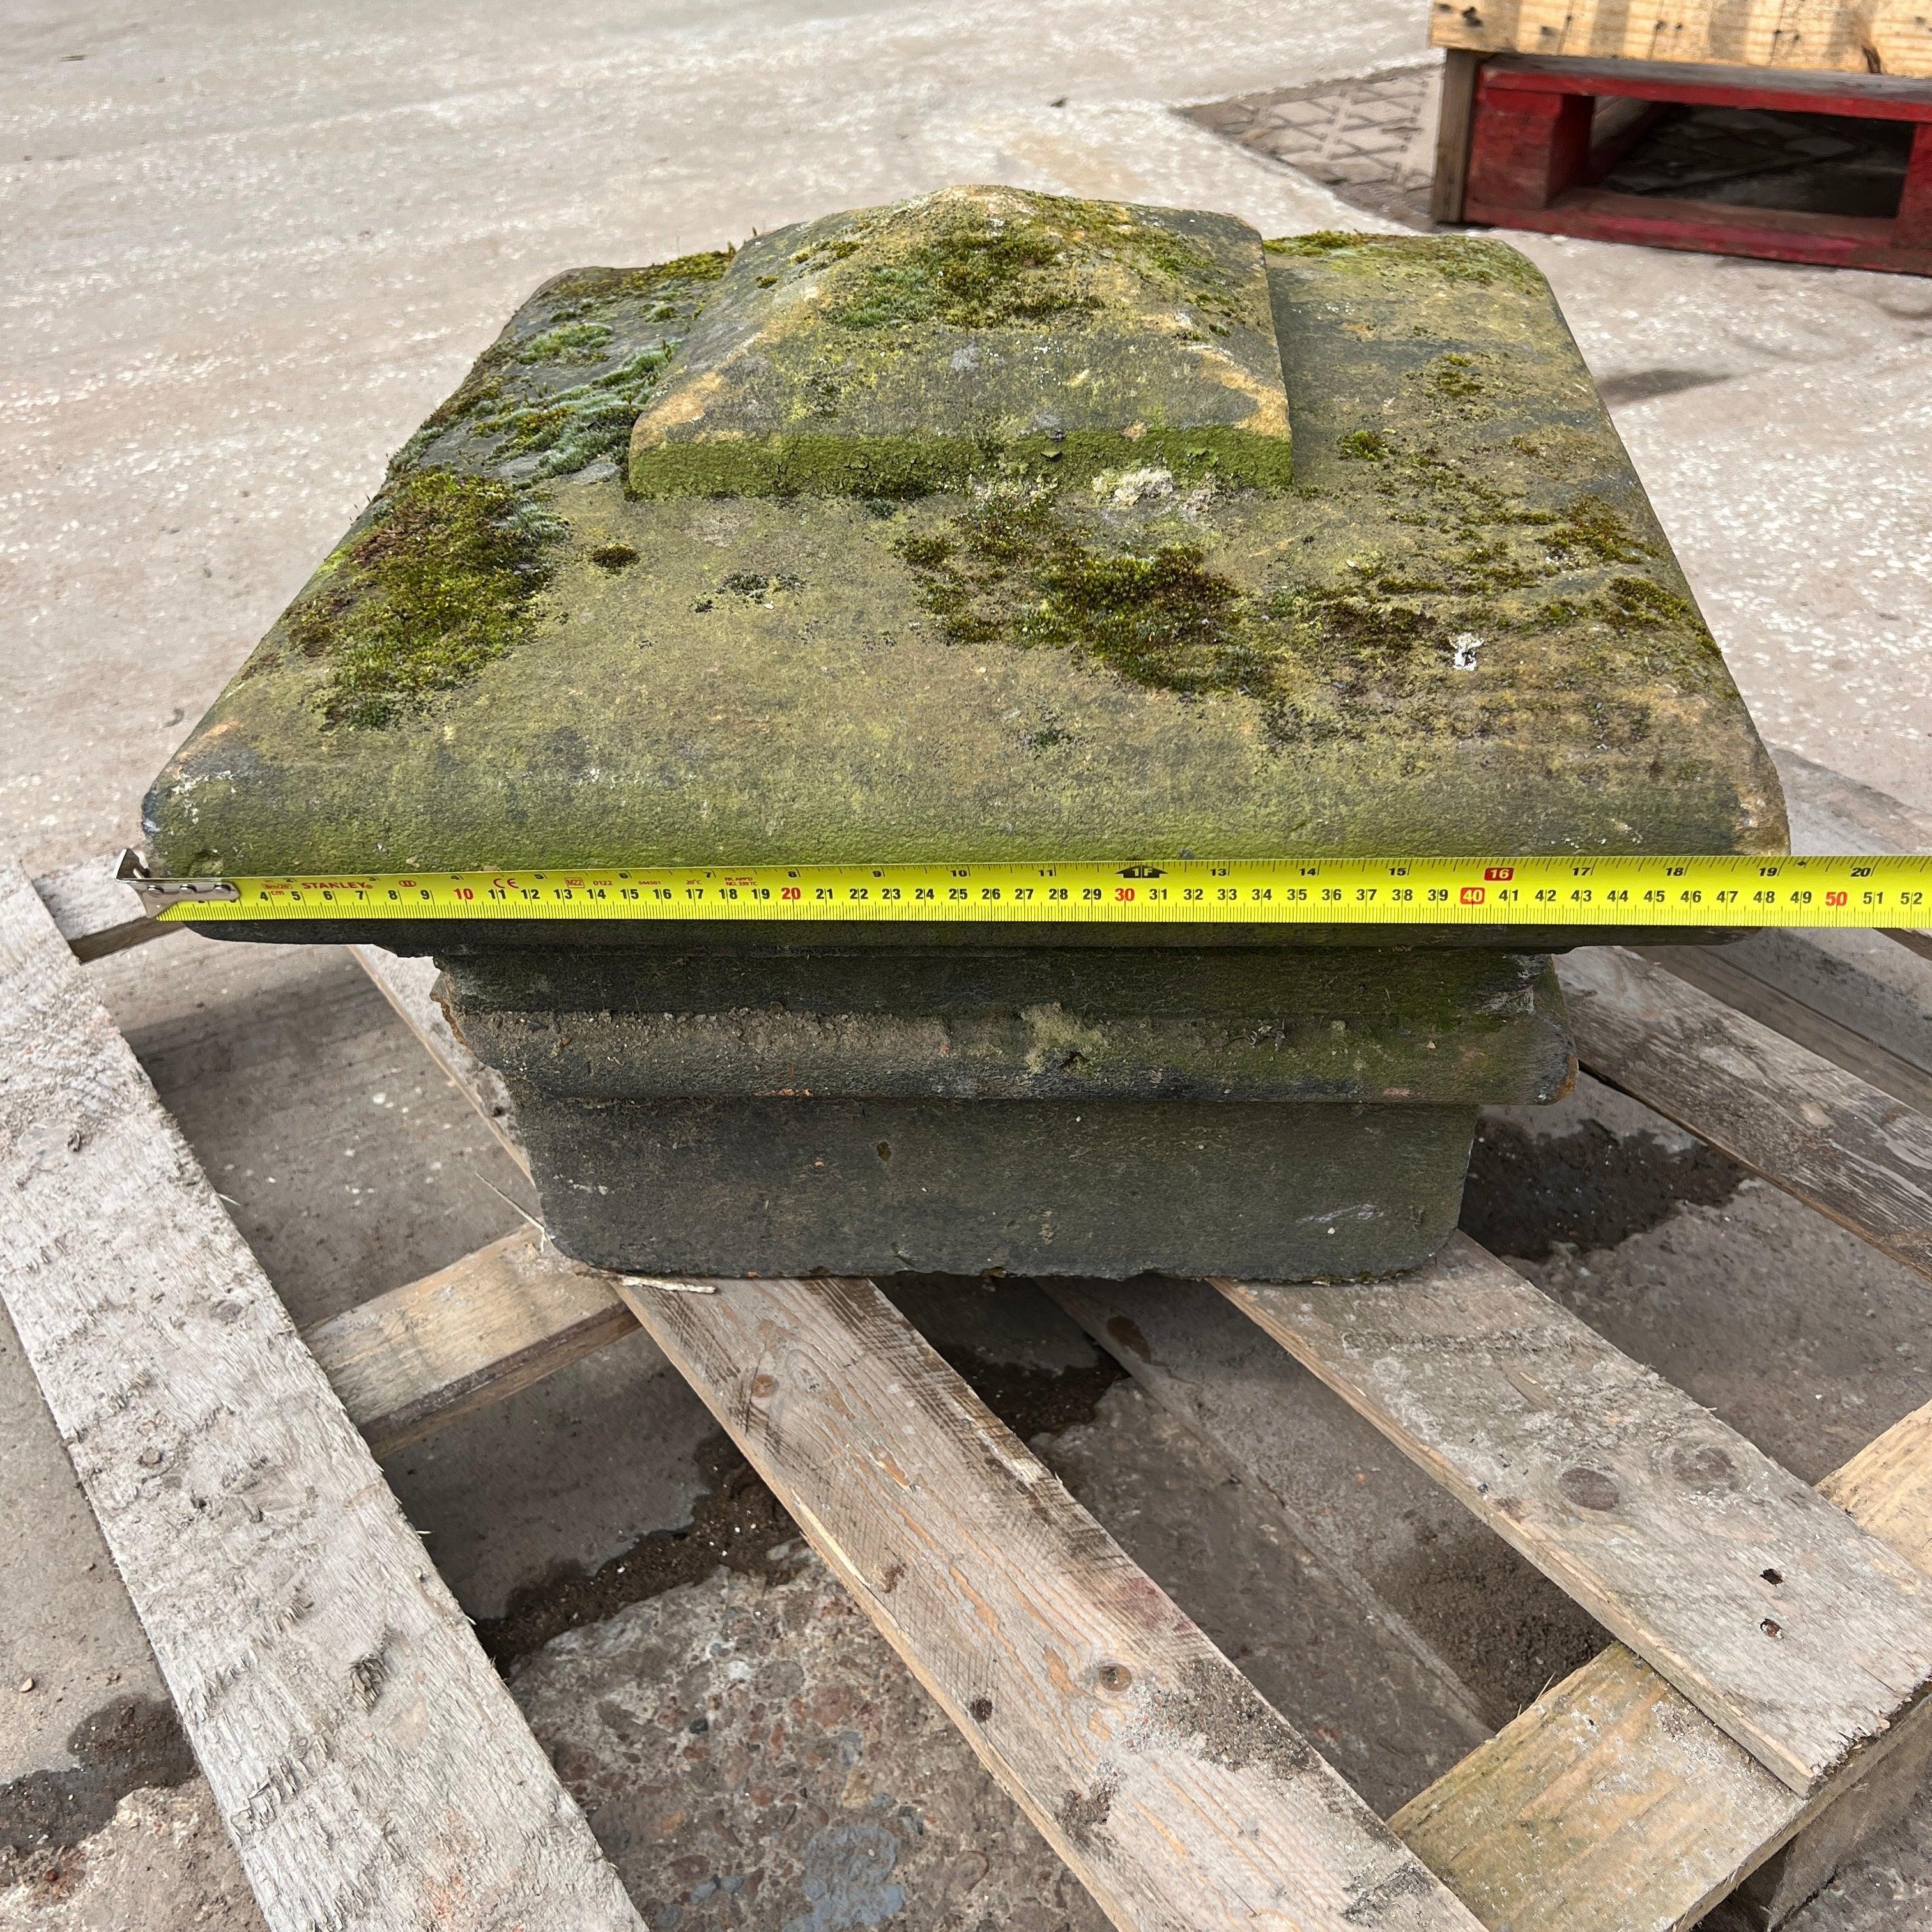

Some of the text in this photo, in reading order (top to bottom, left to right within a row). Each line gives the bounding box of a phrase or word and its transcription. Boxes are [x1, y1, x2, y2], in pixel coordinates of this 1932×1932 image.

[1491, 869, 1510, 878] 16
[1666, 868, 1684, 876] 18
[1759, 868, 1777, 876] 19
[1850, 868, 1871, 877] 20
[260, 892, 268, 900] 4
[291, 891, 300, 900] 5
[323, 891, 333, 900] 6
[355, 891, 364, 900] 7
[388, 890, 397, 900] 8
[420, 890, 429, 900] 9
[454, 889, 473, 900] 10
[488, 889, 506, 899] 11
[521, 889, 540, 899] 12
[554, 889, 572, 899] 13
[586, 889, 606, 899] 14
[620, 889, 639, 899] 15
[653, 889, 671, 899] 16
[686, 889, 703, 899] 17
[719, 889, 737, 900] 18
[751, 889, 770, 899] 19
[781, 887, 801, 900] 20
[816, 889, 833, 899] 21
[850, 889, 868, 900] 22
[882, 889, 901, 900] 23
[916, 889, 934, 900] 24
[949, 889, 968, 900] 25
[982, 889, 1000, 900] 26
[1015, 889, 1034, 900] 27
[1049, 889, 1068, 900] 28
[1083, 889, 1101, 900] 29
[1115, 888, 1135, 901] 30
[1149, 889, 1167, 900] 31
[1184, 889, 1203, 900] 32
[1218, 889, 1237, 900] 33
[1252, 889, 1271, 900] 34
[1287, 889, 1307, 900] 35
[1322, 889, 1342, 900] 36
[1356, 889, 1377, 900] 37
[1392, 889, 1413, 901] 38
[1428, 889, 1448, 901] 39
[1463, 890, 1483, 901] 40
[1499, 889, 1518, 901] 41
[1535, 890, 1556, 901] 42
[1571, 890, 1591, 901] 43
[1607, 890, 1628, 902] 44
[1644, 891, 1665, 902] 45
[1680, 891, 1701, 903] 46
[1717, 891, 1738, 903] 47
[1753, 891, 1775, 903] 48
[1790, 891, 1811, 903] 49
[1825, 892, 1847, 906] 50
[1863, 892, 1883, 904] 51
[1901, 893, 1922, 905] 52
